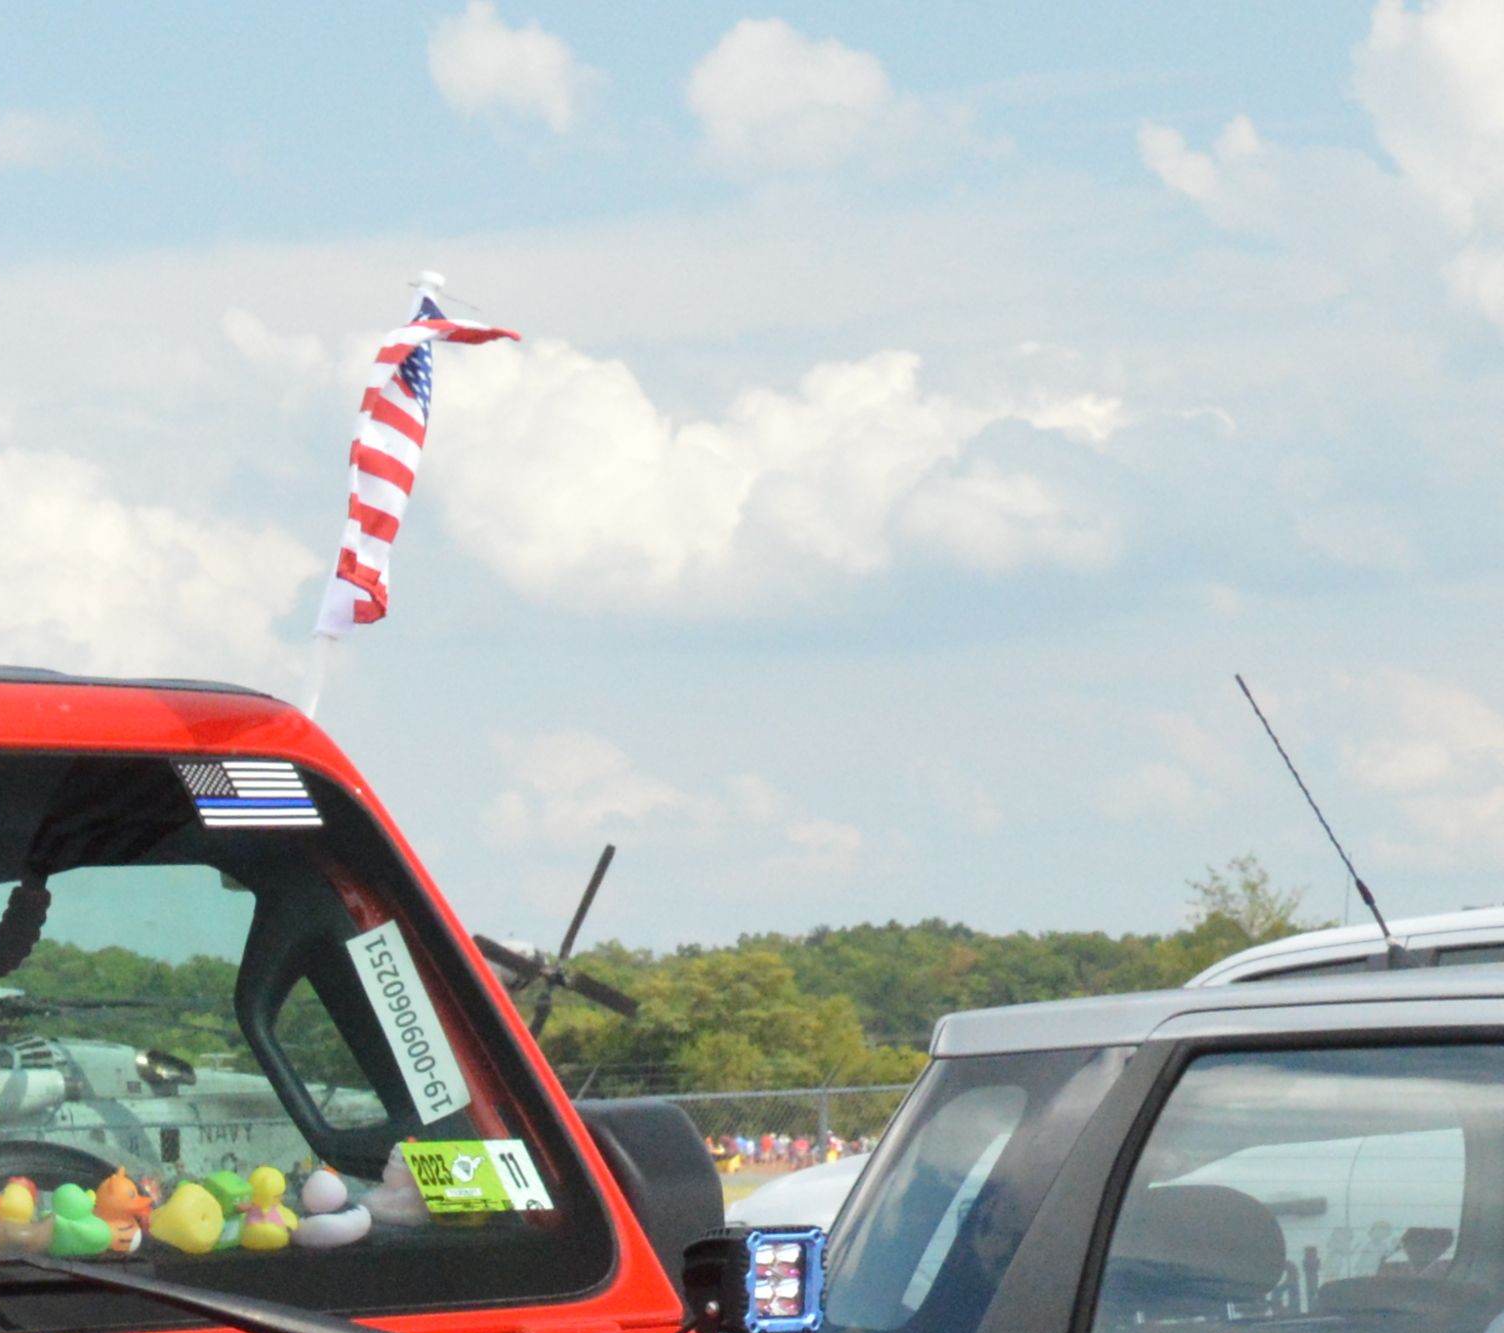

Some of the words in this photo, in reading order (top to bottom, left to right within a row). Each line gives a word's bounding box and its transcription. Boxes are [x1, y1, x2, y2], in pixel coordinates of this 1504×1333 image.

[365, 934, 454, 1113] 19-009060251
[199, 1123, 253, 1143] NAVY
[410, 1153, 455, 1186] 2023
[498, 1152, 530, 1189] 11
